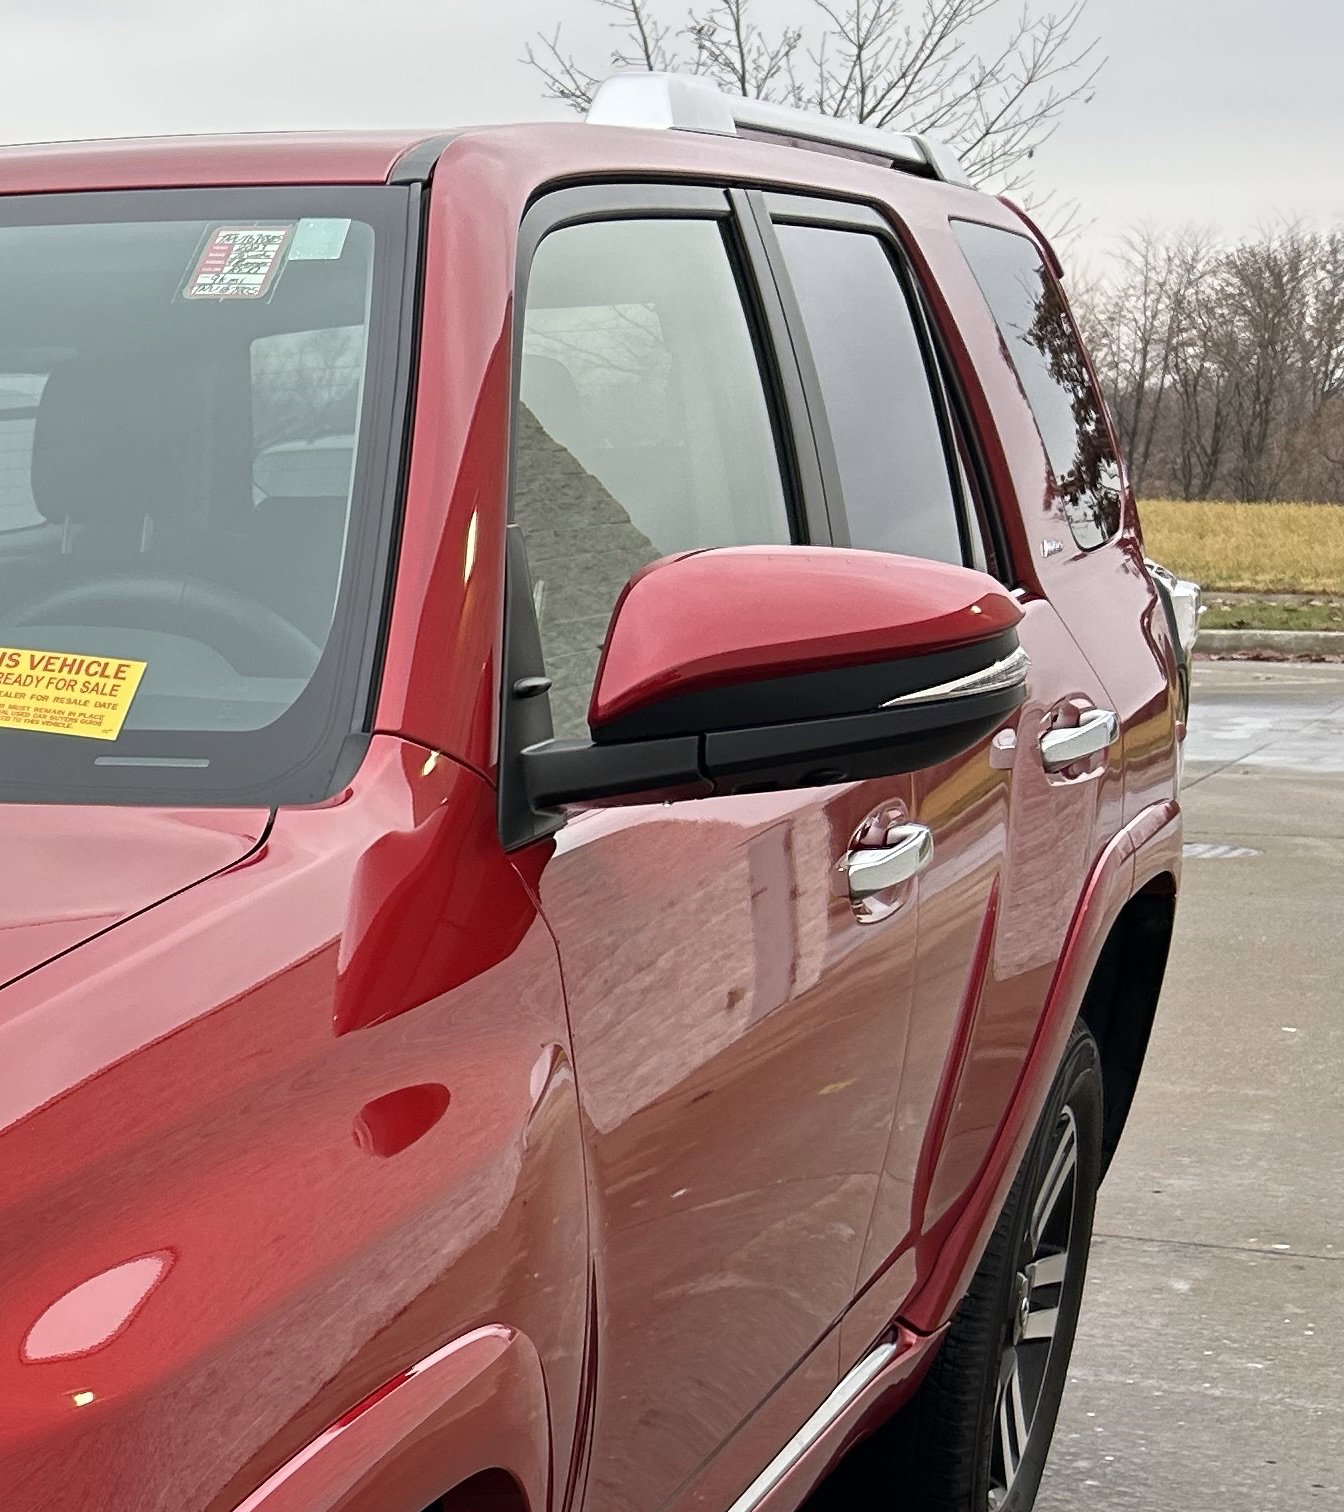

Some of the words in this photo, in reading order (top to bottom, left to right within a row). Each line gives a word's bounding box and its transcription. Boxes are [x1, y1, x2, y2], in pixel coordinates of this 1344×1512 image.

[29, 654, 132, 680] VEHICLE
[46, 676, 78, 692] FOR
[79, 680, 122, 697] SALE
[29, 693, 49, 702] FOR
[52, 696, 90, 707] RESALE
[93, 701, 119, 710] DATE
